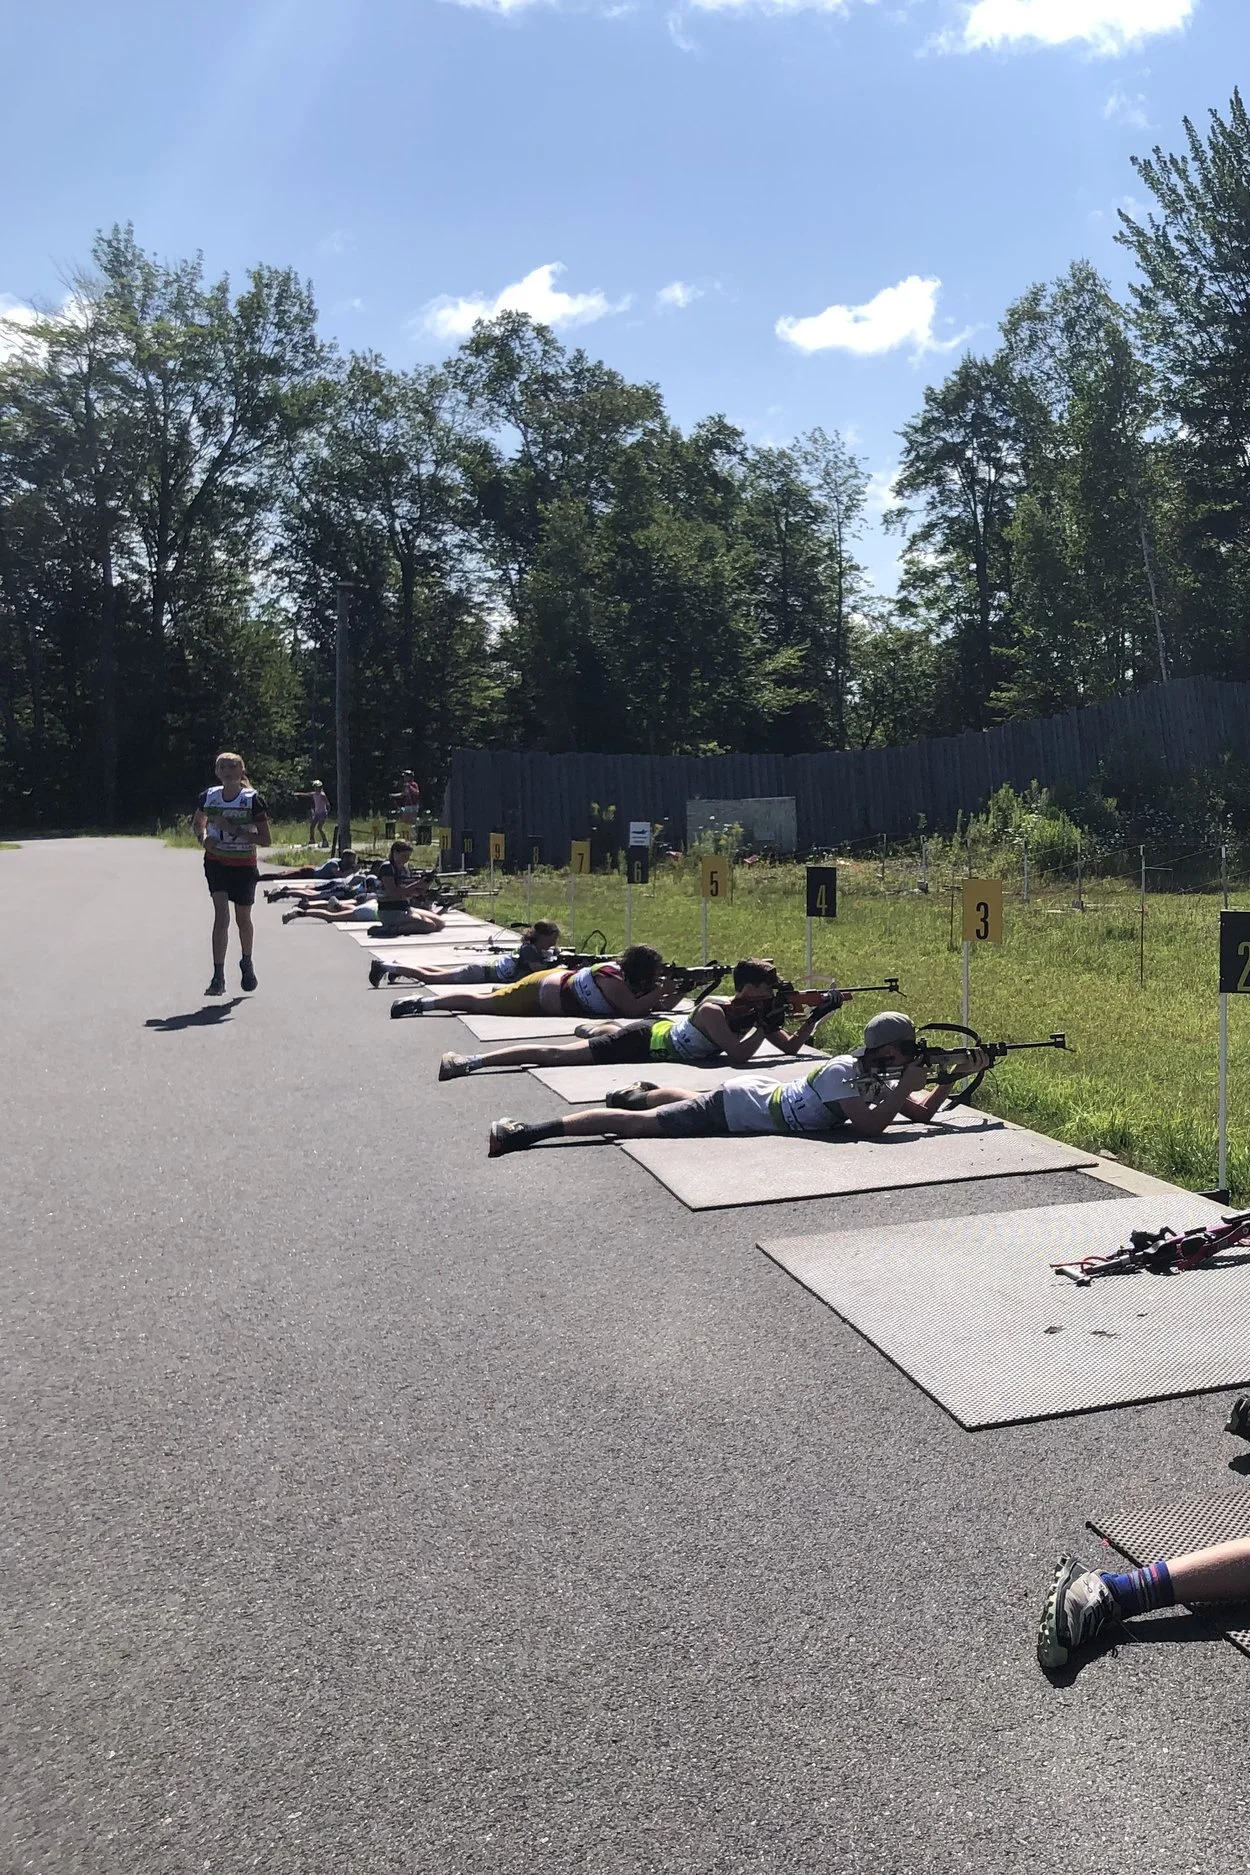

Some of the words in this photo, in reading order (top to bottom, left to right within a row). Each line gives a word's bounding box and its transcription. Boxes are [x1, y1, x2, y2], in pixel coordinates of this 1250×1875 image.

[577, 853, 584, 873] 7
[634, 861, 641, 882] 6
[710, 871, 718, 896] 5
[816, 884, 828, 915] 4
[975, 902, 989, 940] 3
